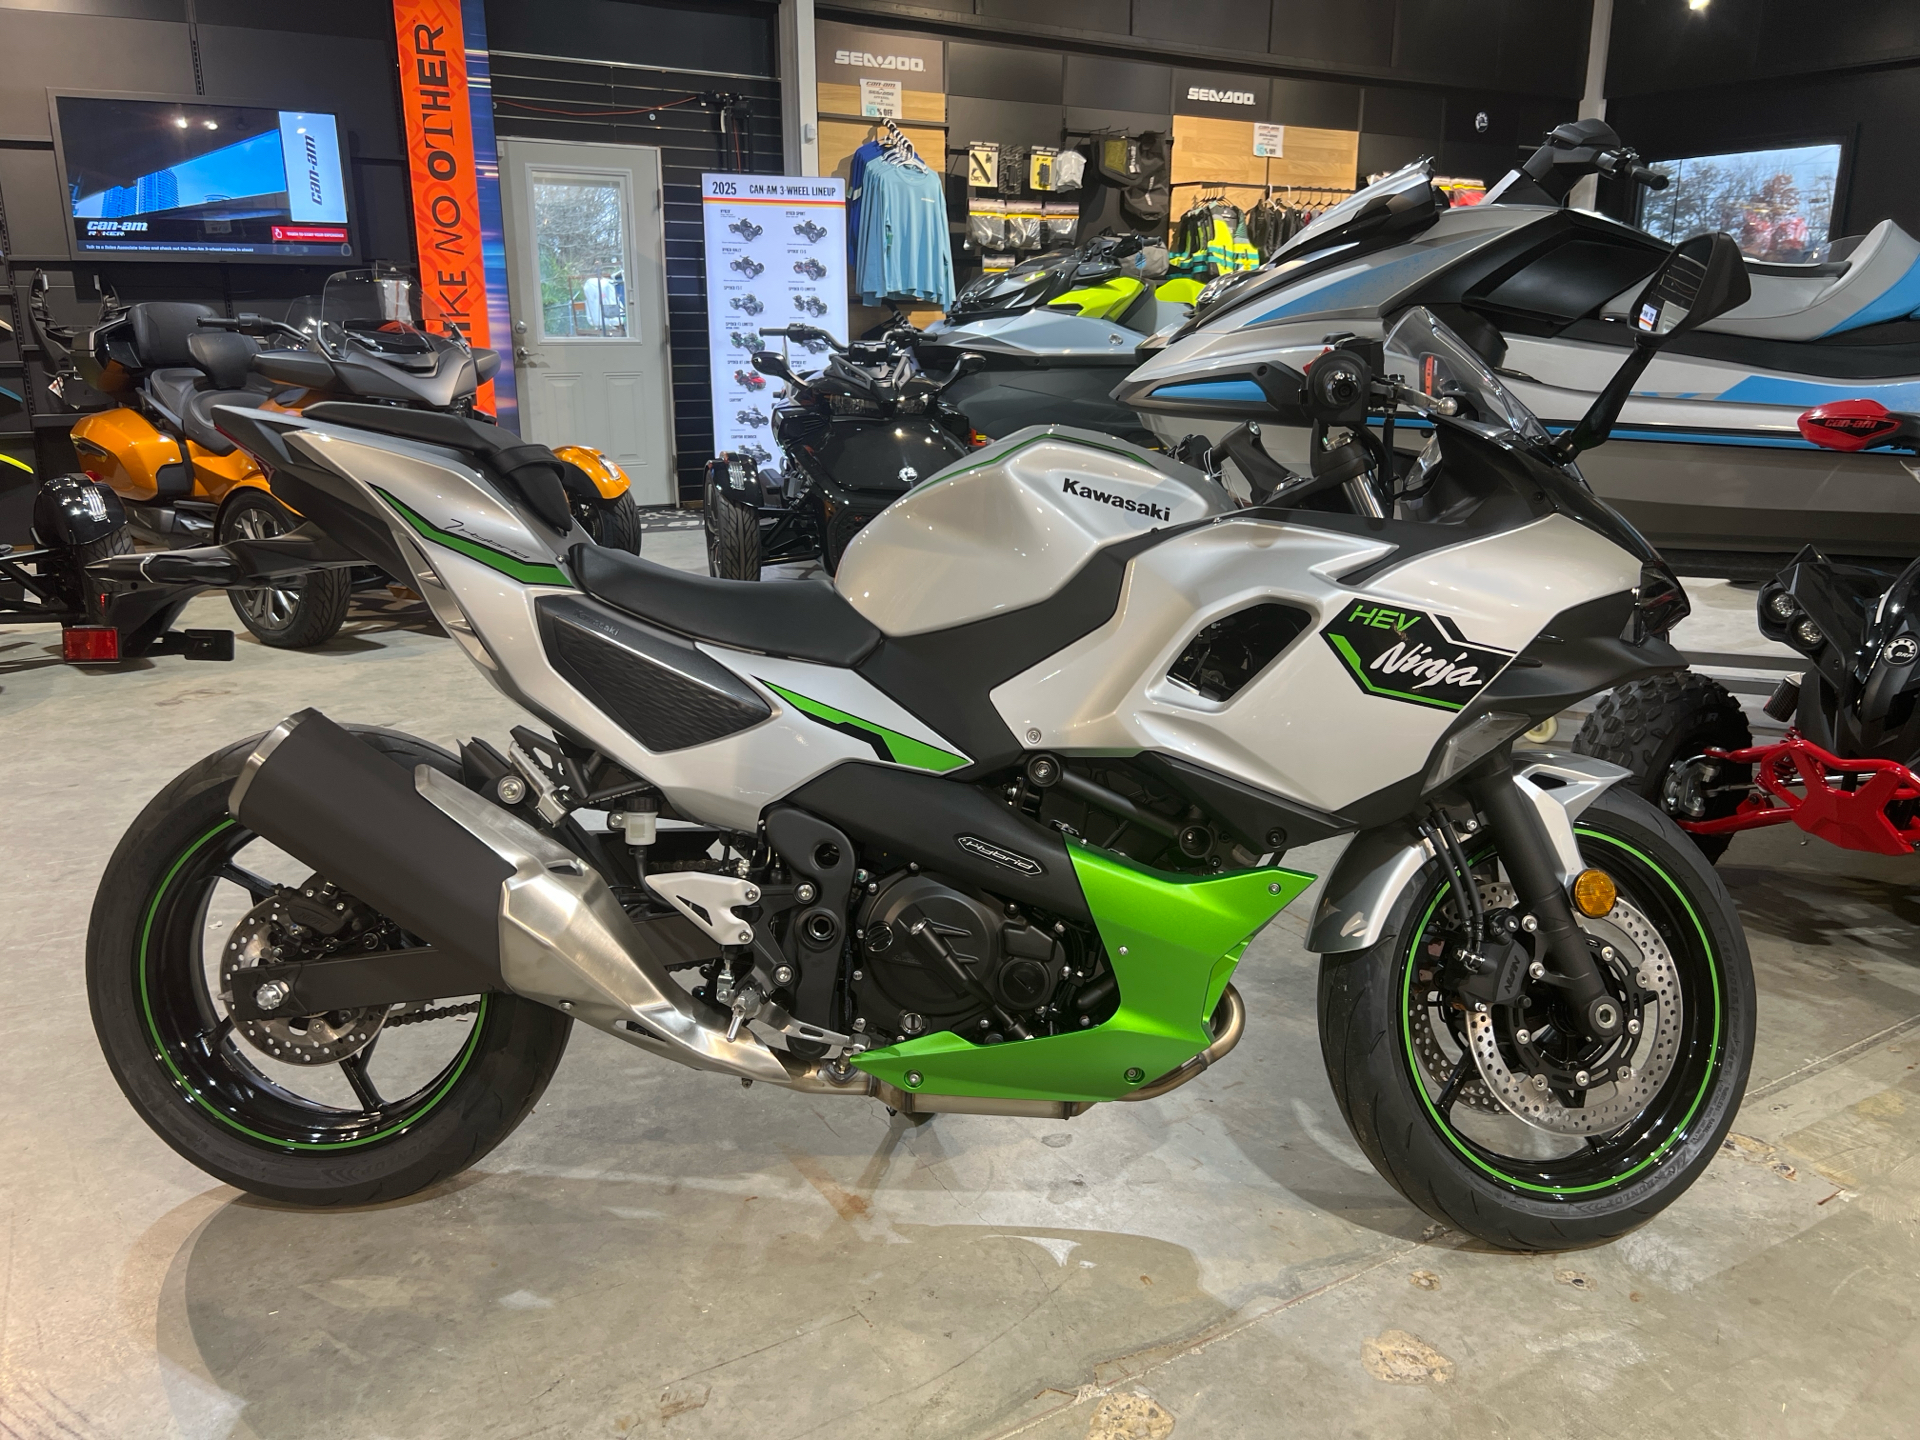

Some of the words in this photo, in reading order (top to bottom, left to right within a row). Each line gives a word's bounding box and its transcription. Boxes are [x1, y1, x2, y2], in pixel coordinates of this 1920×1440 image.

[413, 23, 458, 182] OTHER
[883, 108, 893, 117] OFF
[304, 134, 323, 206] can-am
[712, 181, 737, 195] 2025
[749, 184, 778, 195] CAN-AM
[780, 185, 810, 196] 3-WHEEL
[811, 186, 836, 197] LINEUP
[86, 221, 148, 232] can-am
[431, 195, 465, 255] NO
[438, 270, 473, 348] IKE
[1824, 419, 1879, 429] can-am
[1062, 477, 1171, 522] Kawasaki
[1347, 604, 1422, 632] HEV
[1369, 641, 1483, 690] Ninja
